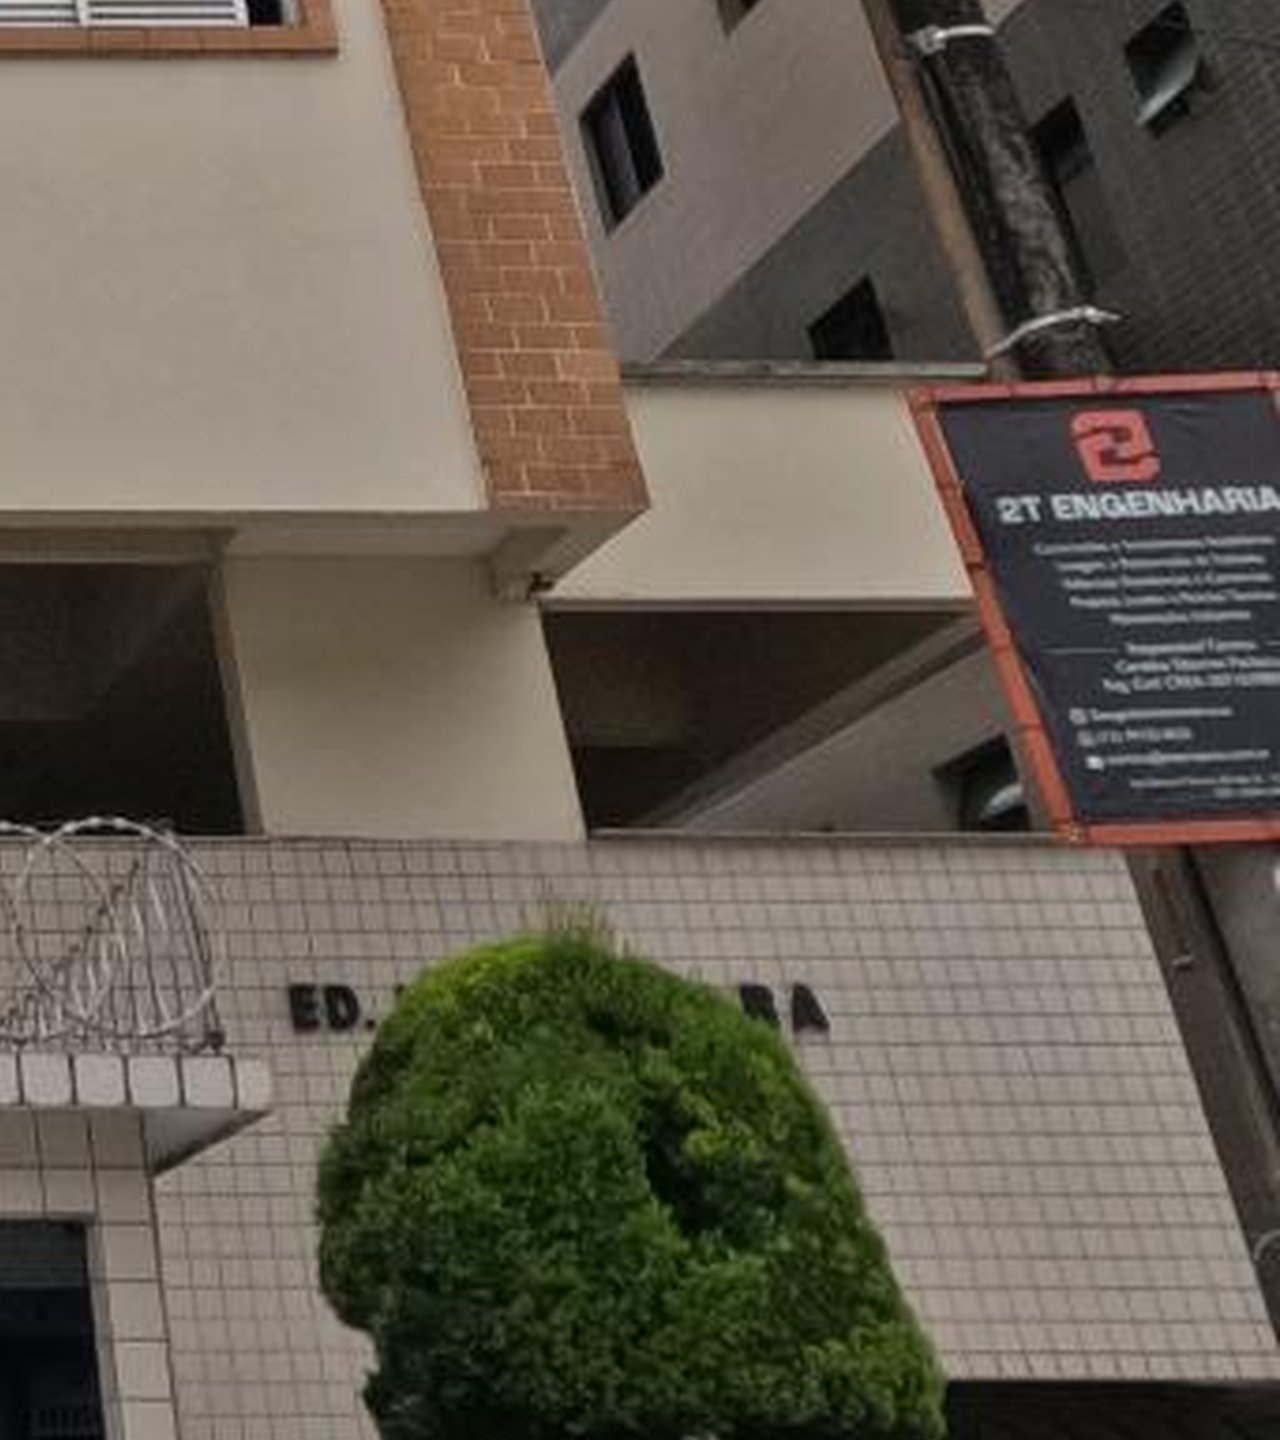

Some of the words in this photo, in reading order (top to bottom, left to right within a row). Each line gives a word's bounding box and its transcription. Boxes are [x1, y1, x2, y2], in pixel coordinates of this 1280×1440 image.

[996, 496, 1041, 523] 2T
[1051, 487, 1280, 520] ENGENHARIA
[288, 983, 376, 1034] ED.
